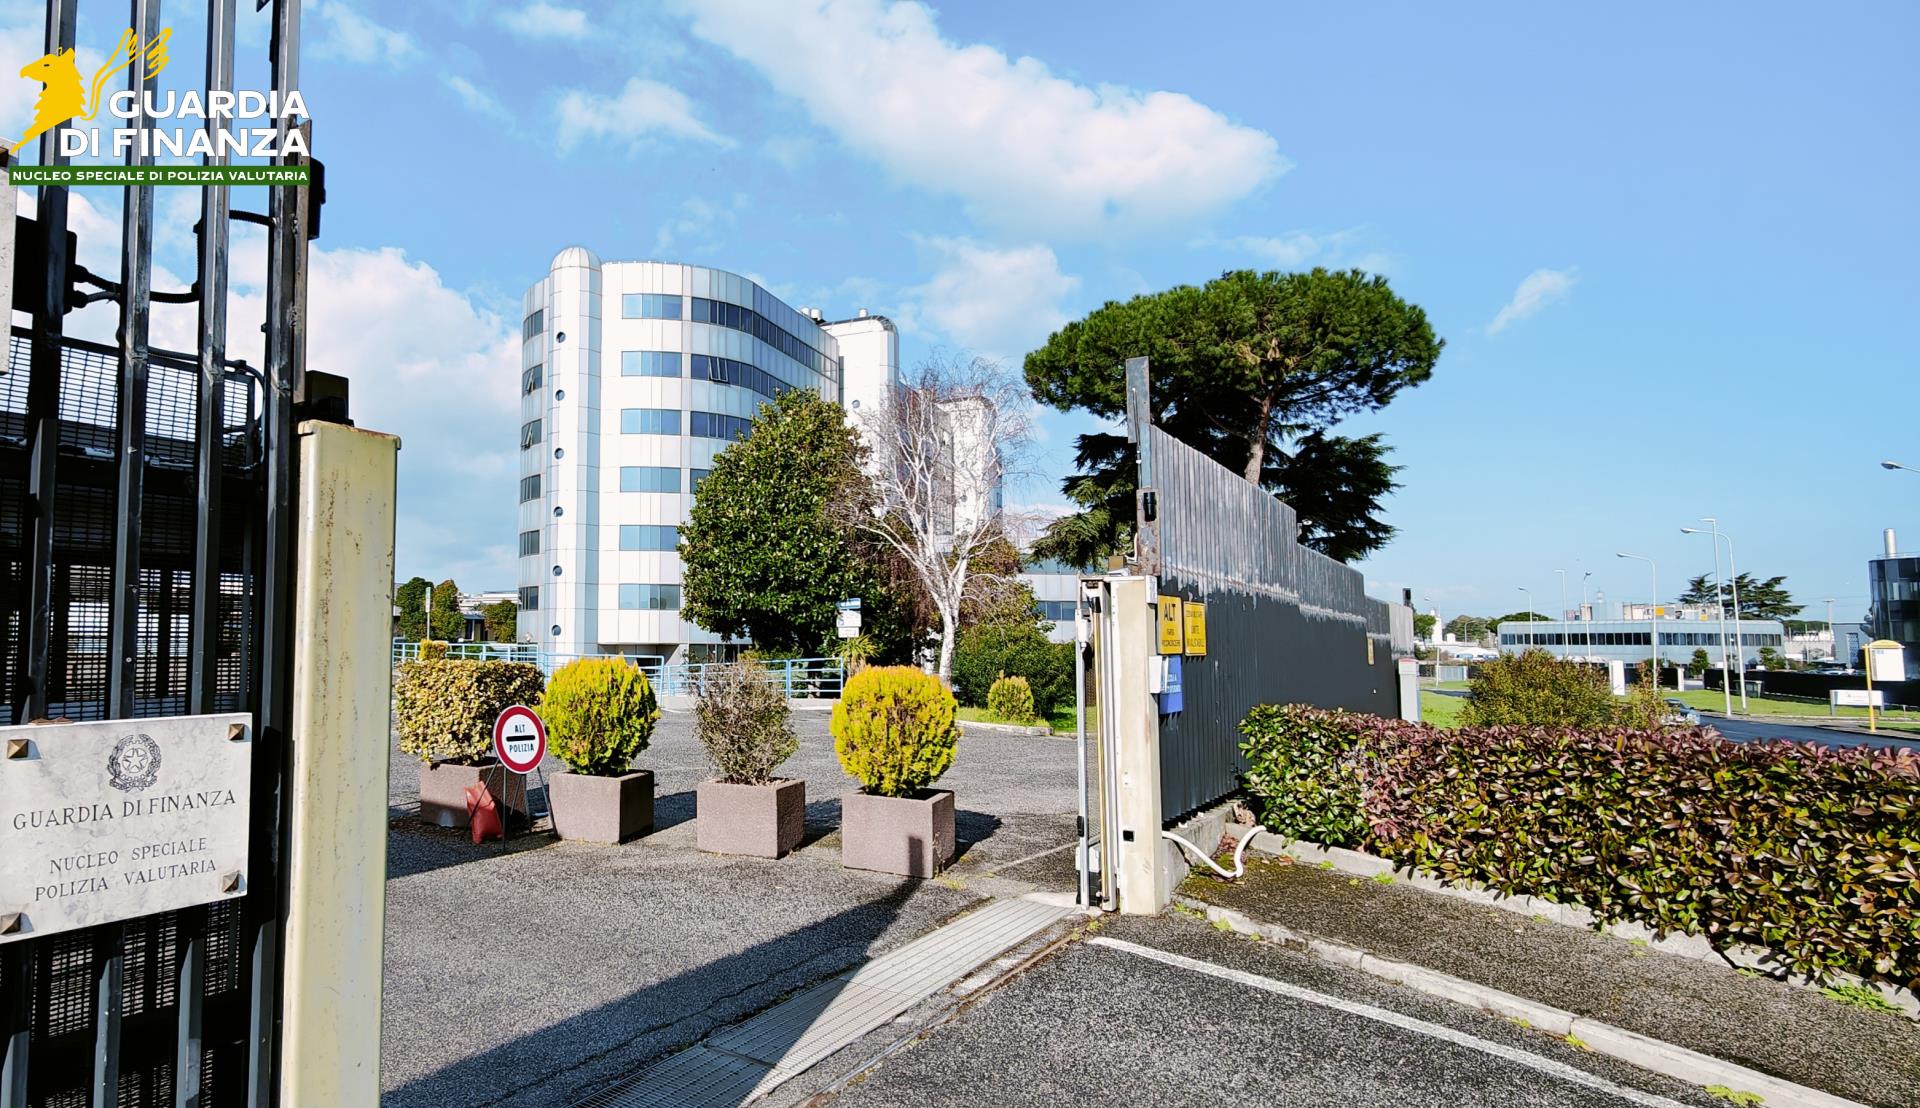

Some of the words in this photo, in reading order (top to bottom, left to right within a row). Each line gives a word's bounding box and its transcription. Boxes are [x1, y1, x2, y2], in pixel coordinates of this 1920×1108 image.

[1164, 603, 1176, 621] ALT
[514, 724, 525, 733] ALT
[509, 743, 534, 753] POLIZIA
[13, 804, 114, 830] GUARDIA
[122, 800, 141, 818] DI
[149, 789, 236, 815] FINANZA
[50, 850, 119, 874] NUCLEO
[131, 837, 207, 861] SPECIALE
[35, 877, 109, 901] POLIZIA
[124, 859, 217, 886] VALUTARIA
